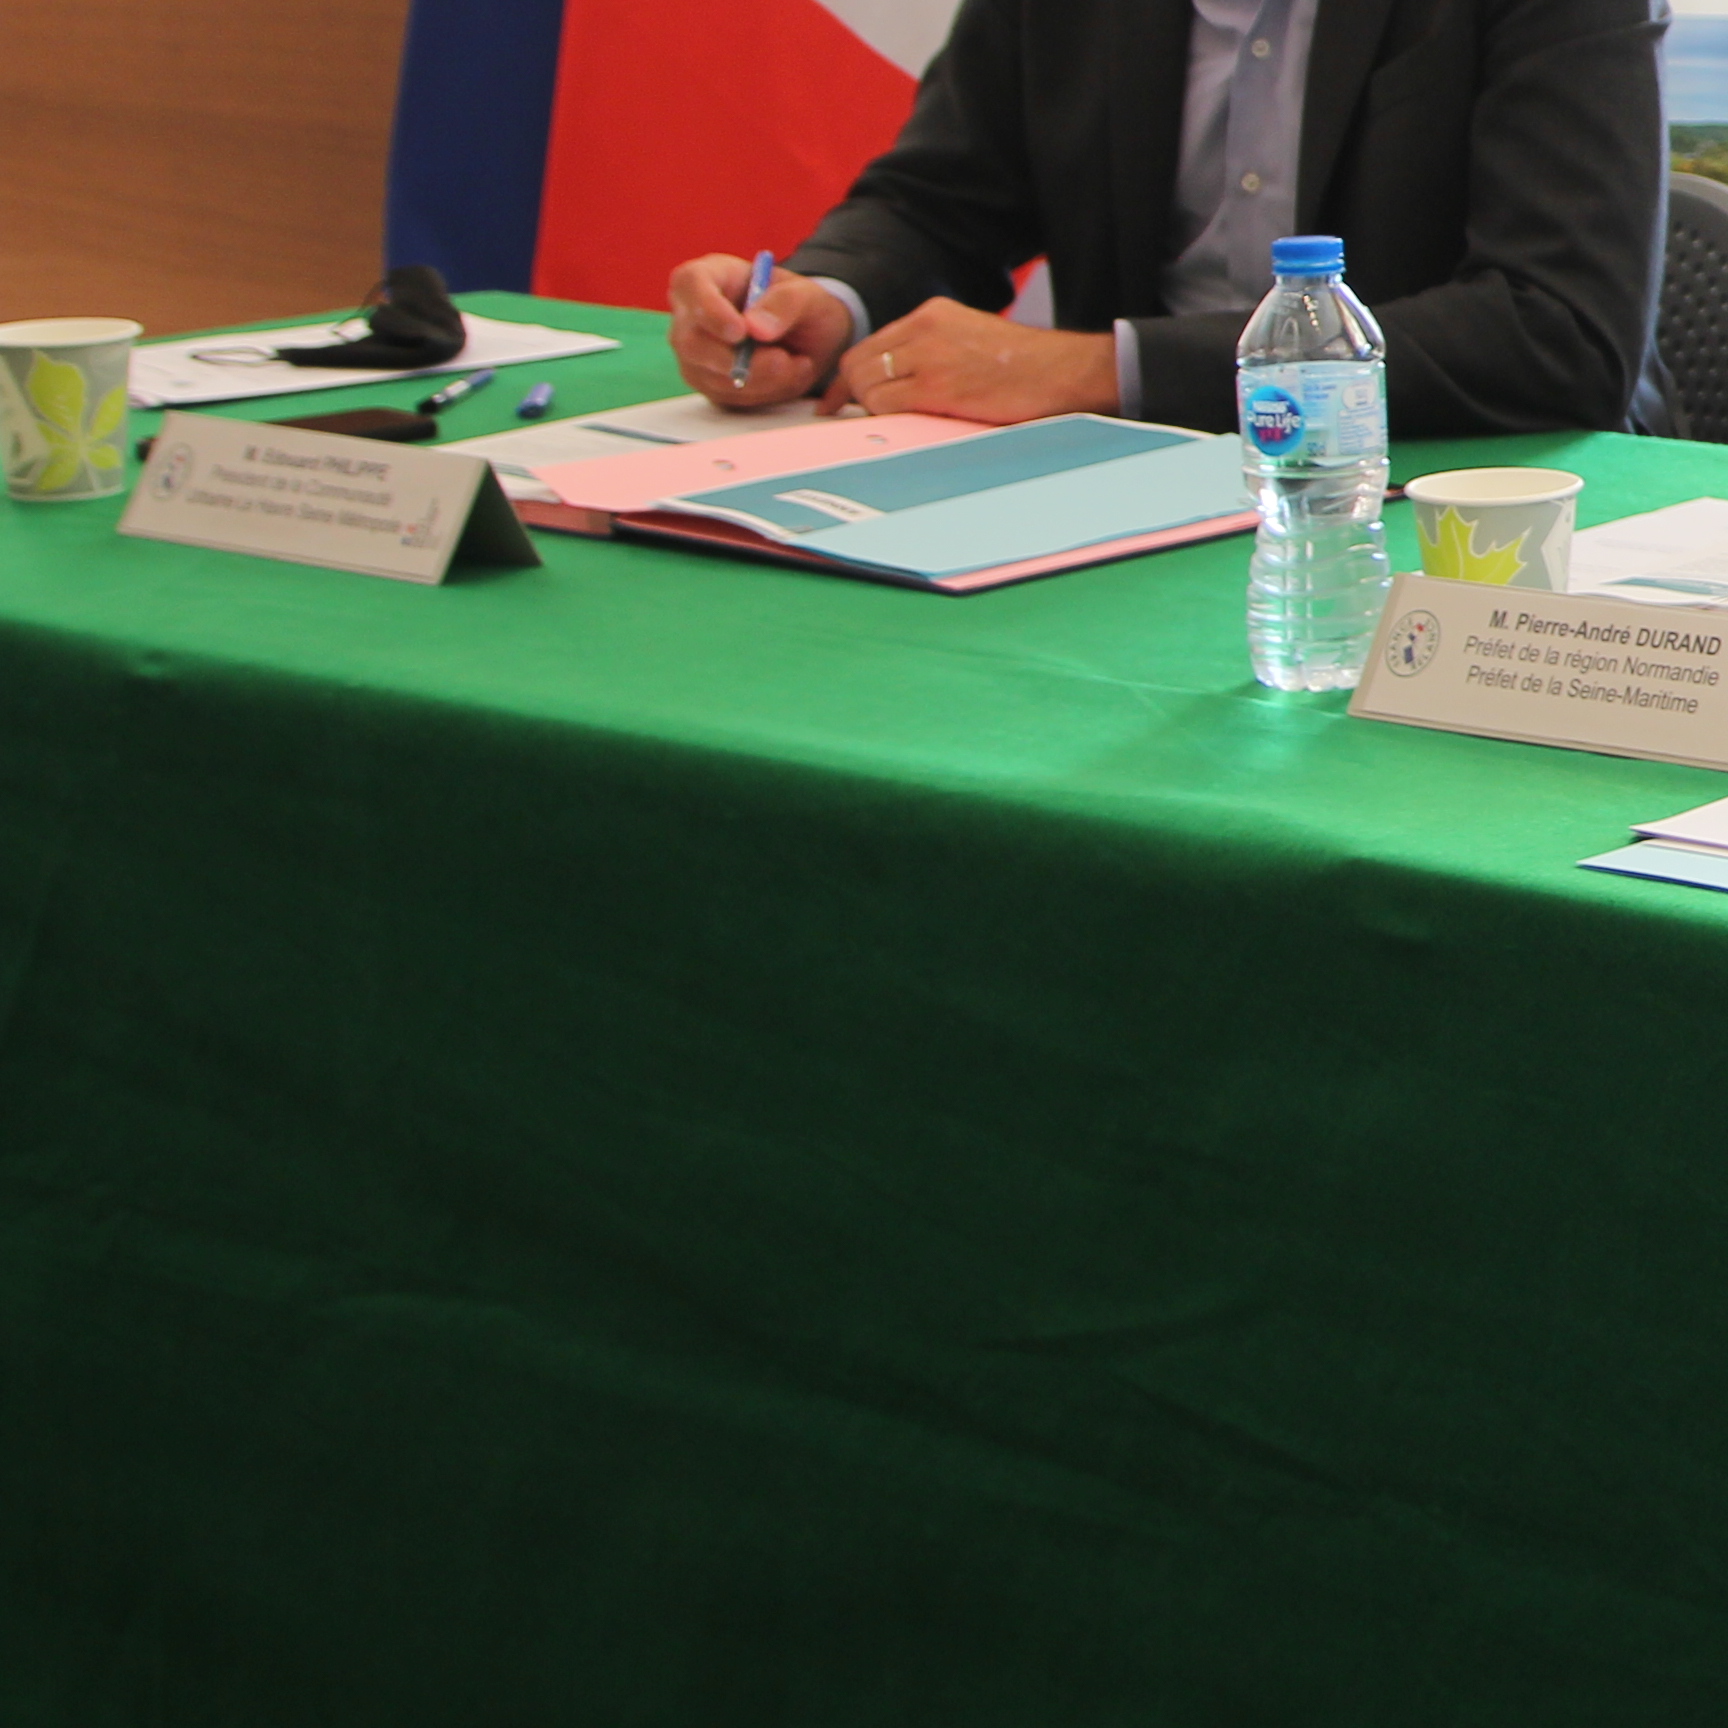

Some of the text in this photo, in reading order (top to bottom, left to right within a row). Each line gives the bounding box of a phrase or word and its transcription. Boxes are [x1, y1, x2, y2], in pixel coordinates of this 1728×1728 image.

[1246, 411, 1301, 434] Pure Life
[1489, 610, 1722, 656] M. Pierre-André DURAND
[1463, 635, 1720, 686] Préfet de la région Normandie
[1465, 665, 1699, 714] Préfet de la Seine-Maritime
